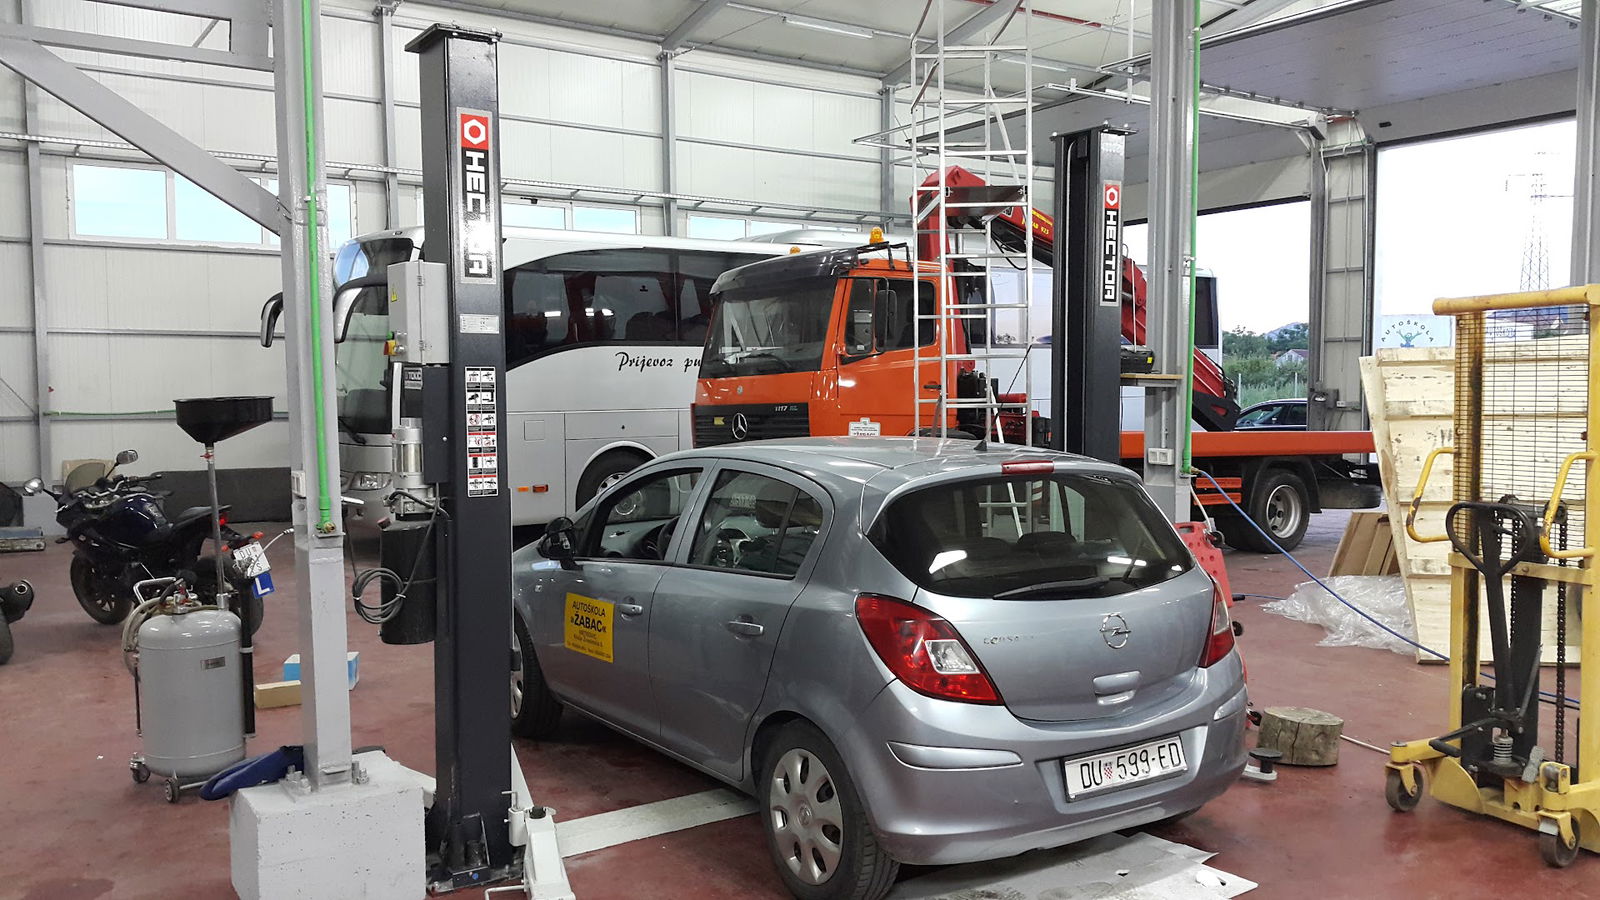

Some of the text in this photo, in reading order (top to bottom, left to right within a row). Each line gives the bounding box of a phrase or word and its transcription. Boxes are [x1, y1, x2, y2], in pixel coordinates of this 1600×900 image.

[464, 150, 488, 275] HECR
[1104, 210, 1118, 300] HECTOR
[615, 351, 674, 373] Prijevoz
[254, 577, 270, 595] L
[572, 600, 606, 618] AUTOŠKOLA
[1080, 742, 1182, 789] DU 599-ED
